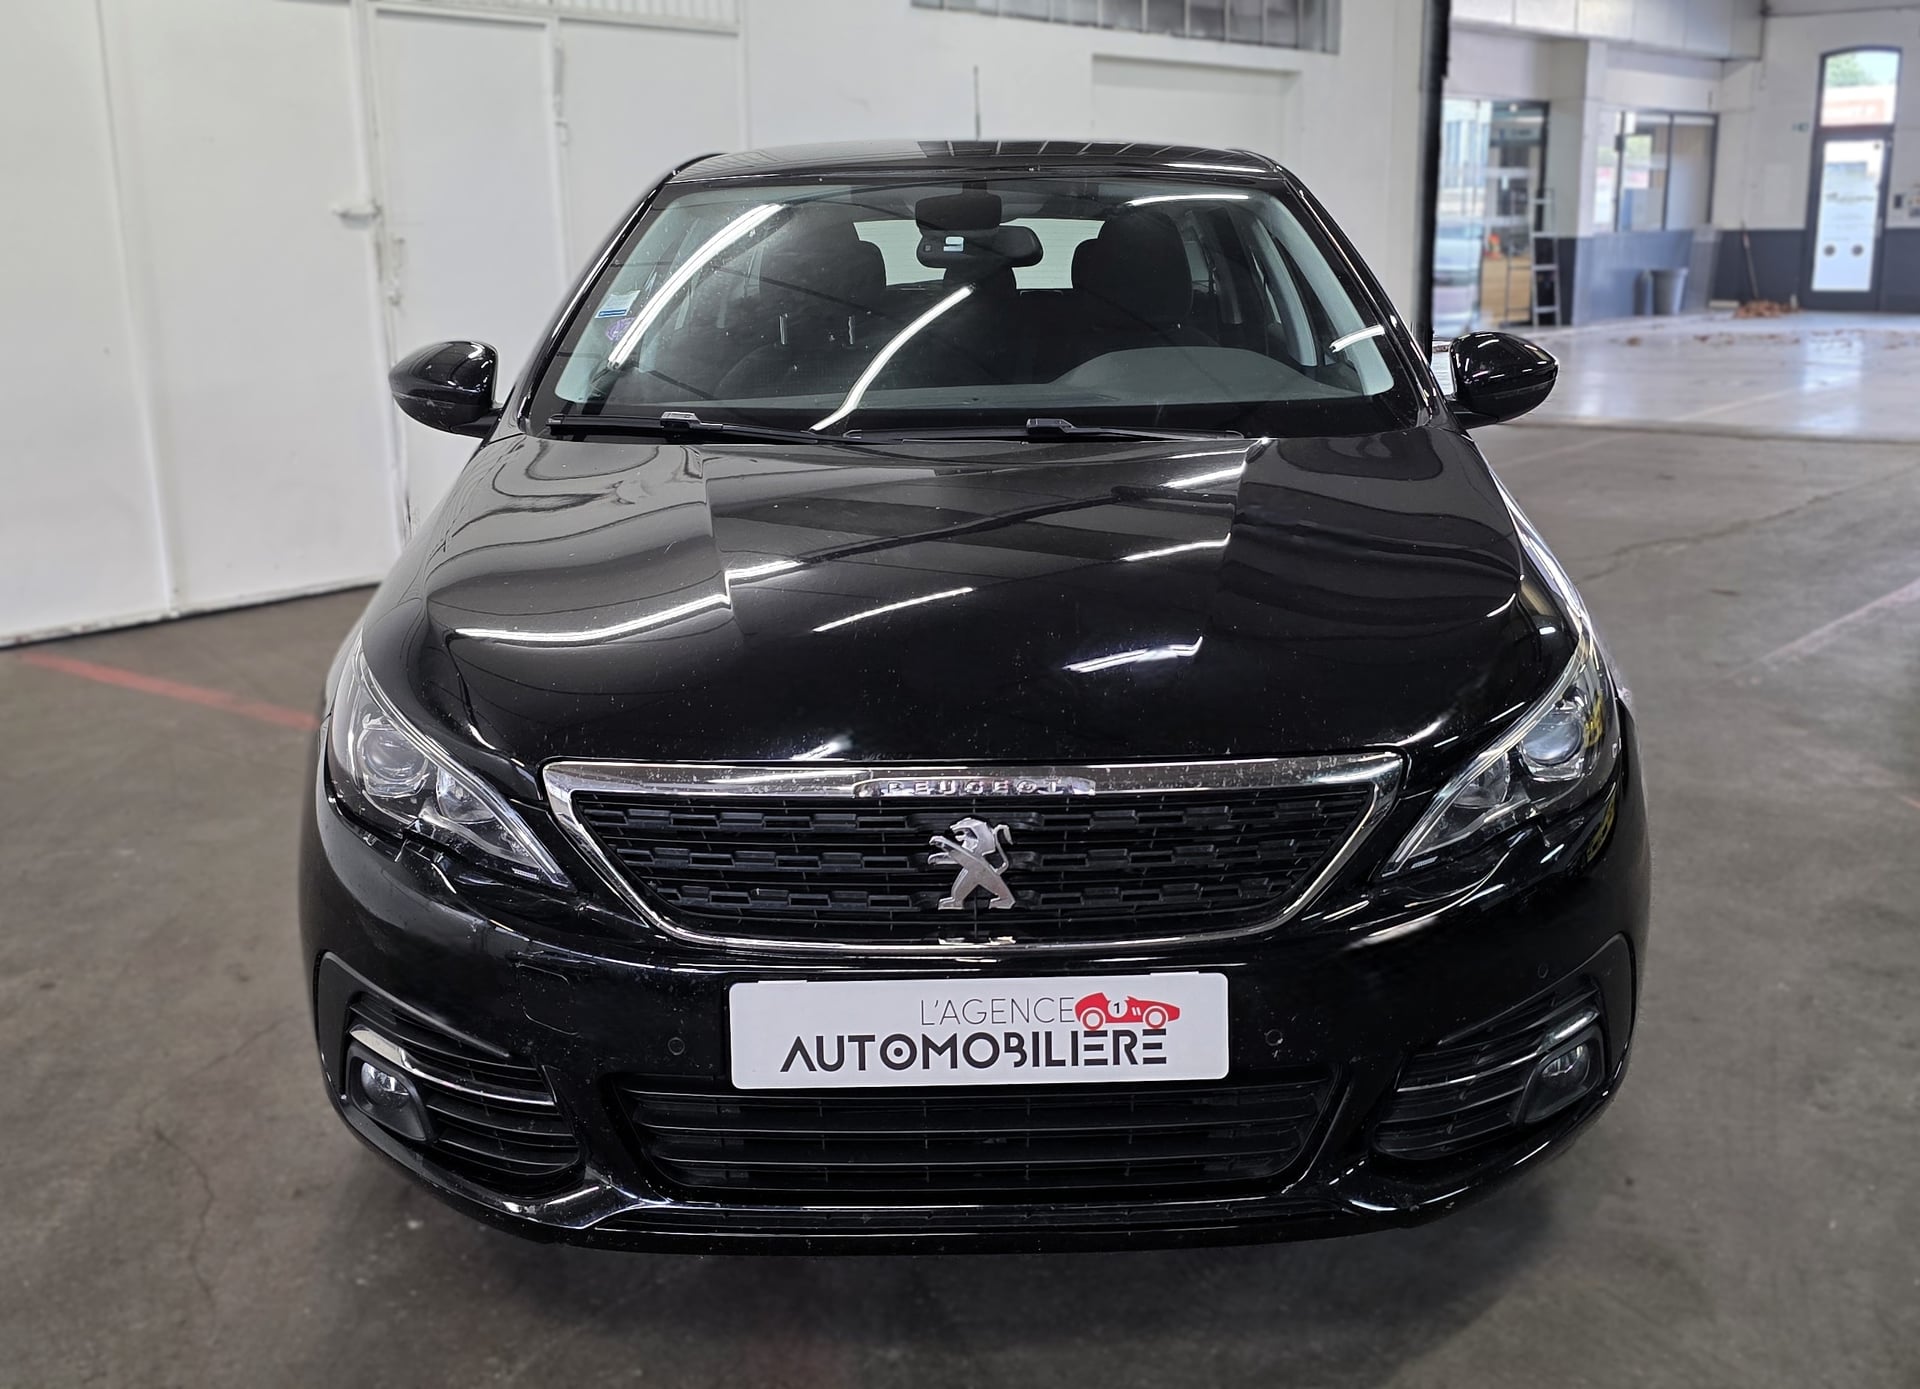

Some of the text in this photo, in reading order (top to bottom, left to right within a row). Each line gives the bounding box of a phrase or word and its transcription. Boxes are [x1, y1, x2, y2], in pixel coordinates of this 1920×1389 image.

[887, 778, 1063, 796] PEUGEOT
[920, 996, 1076, 1026] L'AGENCE
[779, 1028, 1168, 1073] AUTOMOBILIERE
